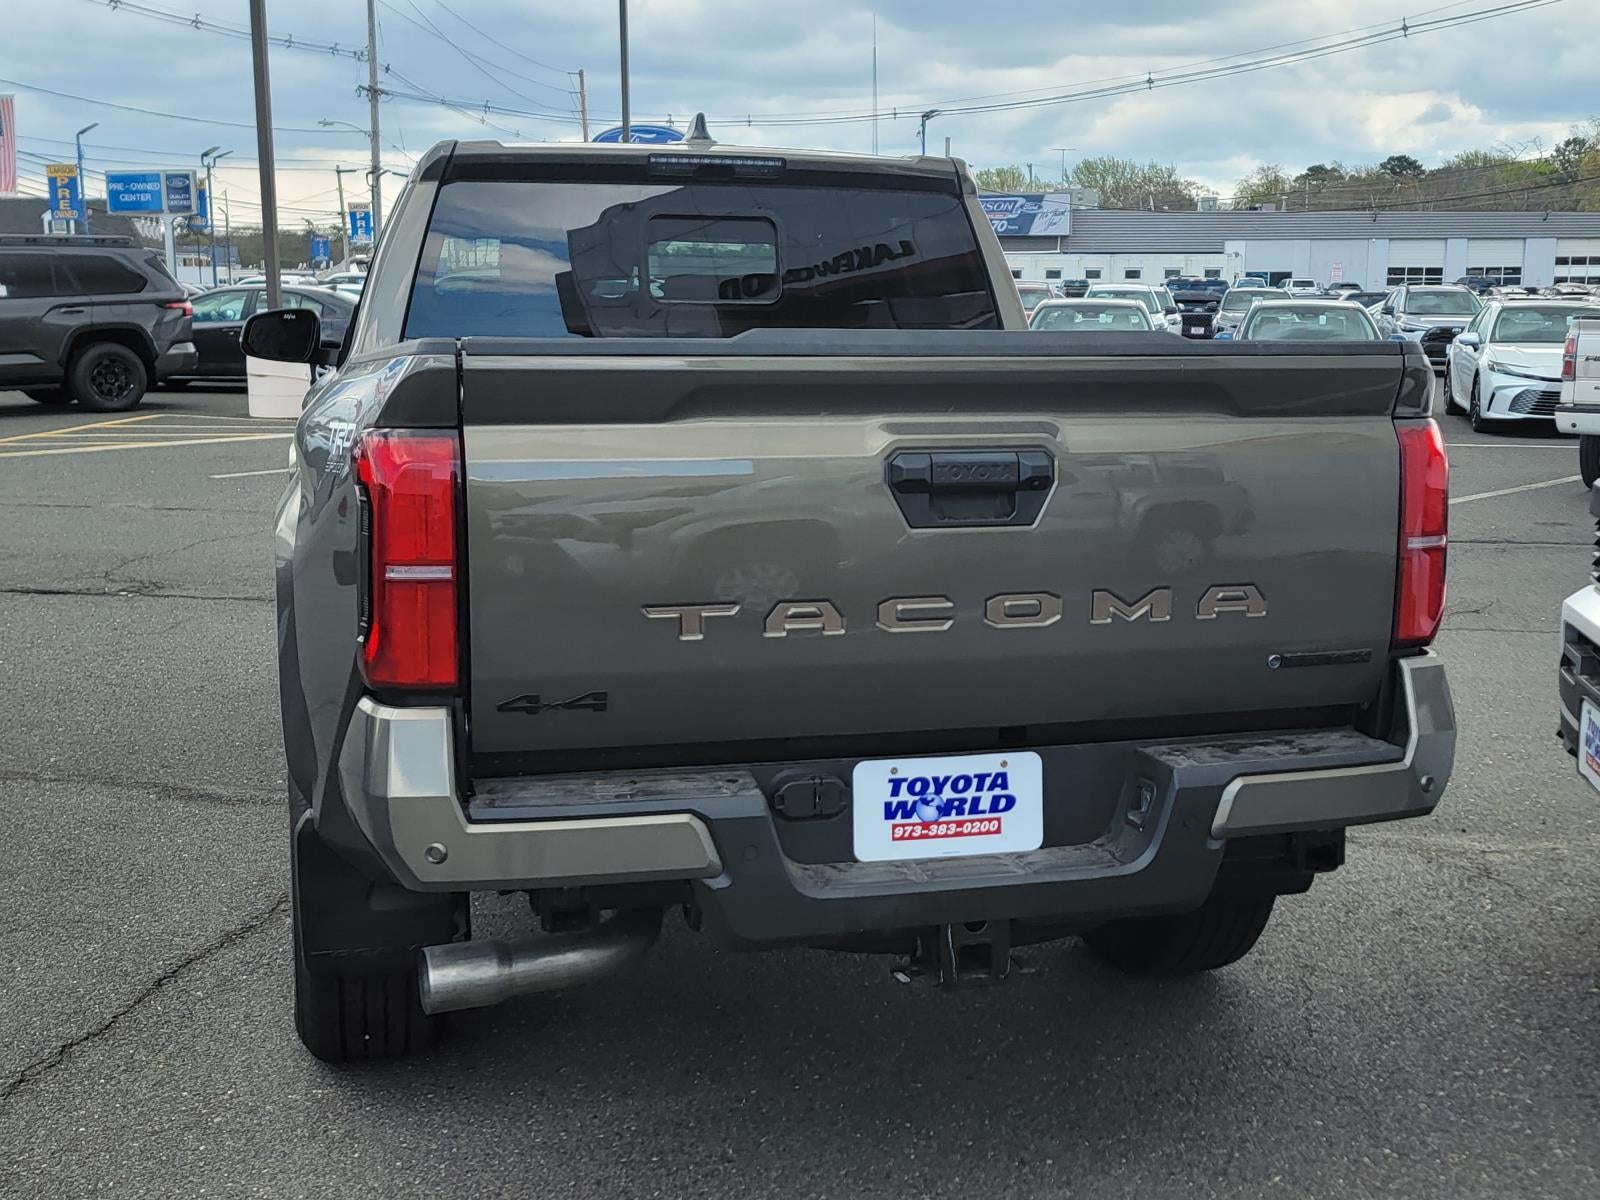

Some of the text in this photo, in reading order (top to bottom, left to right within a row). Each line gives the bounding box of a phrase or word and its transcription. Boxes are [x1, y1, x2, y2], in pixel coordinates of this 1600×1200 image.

[57, 176, 71, 210] PRE
[120, 193, 152, 201] CENTER
[54, 209, 79, 218] OWNED
[329, 421, 357, 455] TRD
[937, 464, 1016, 480] TOYOTA
[641, 583, 1268, 642] TACOMA
[888, 771, 1009, 797] TOYOTA
[894, 820, 998, 838] 973-383-0200
